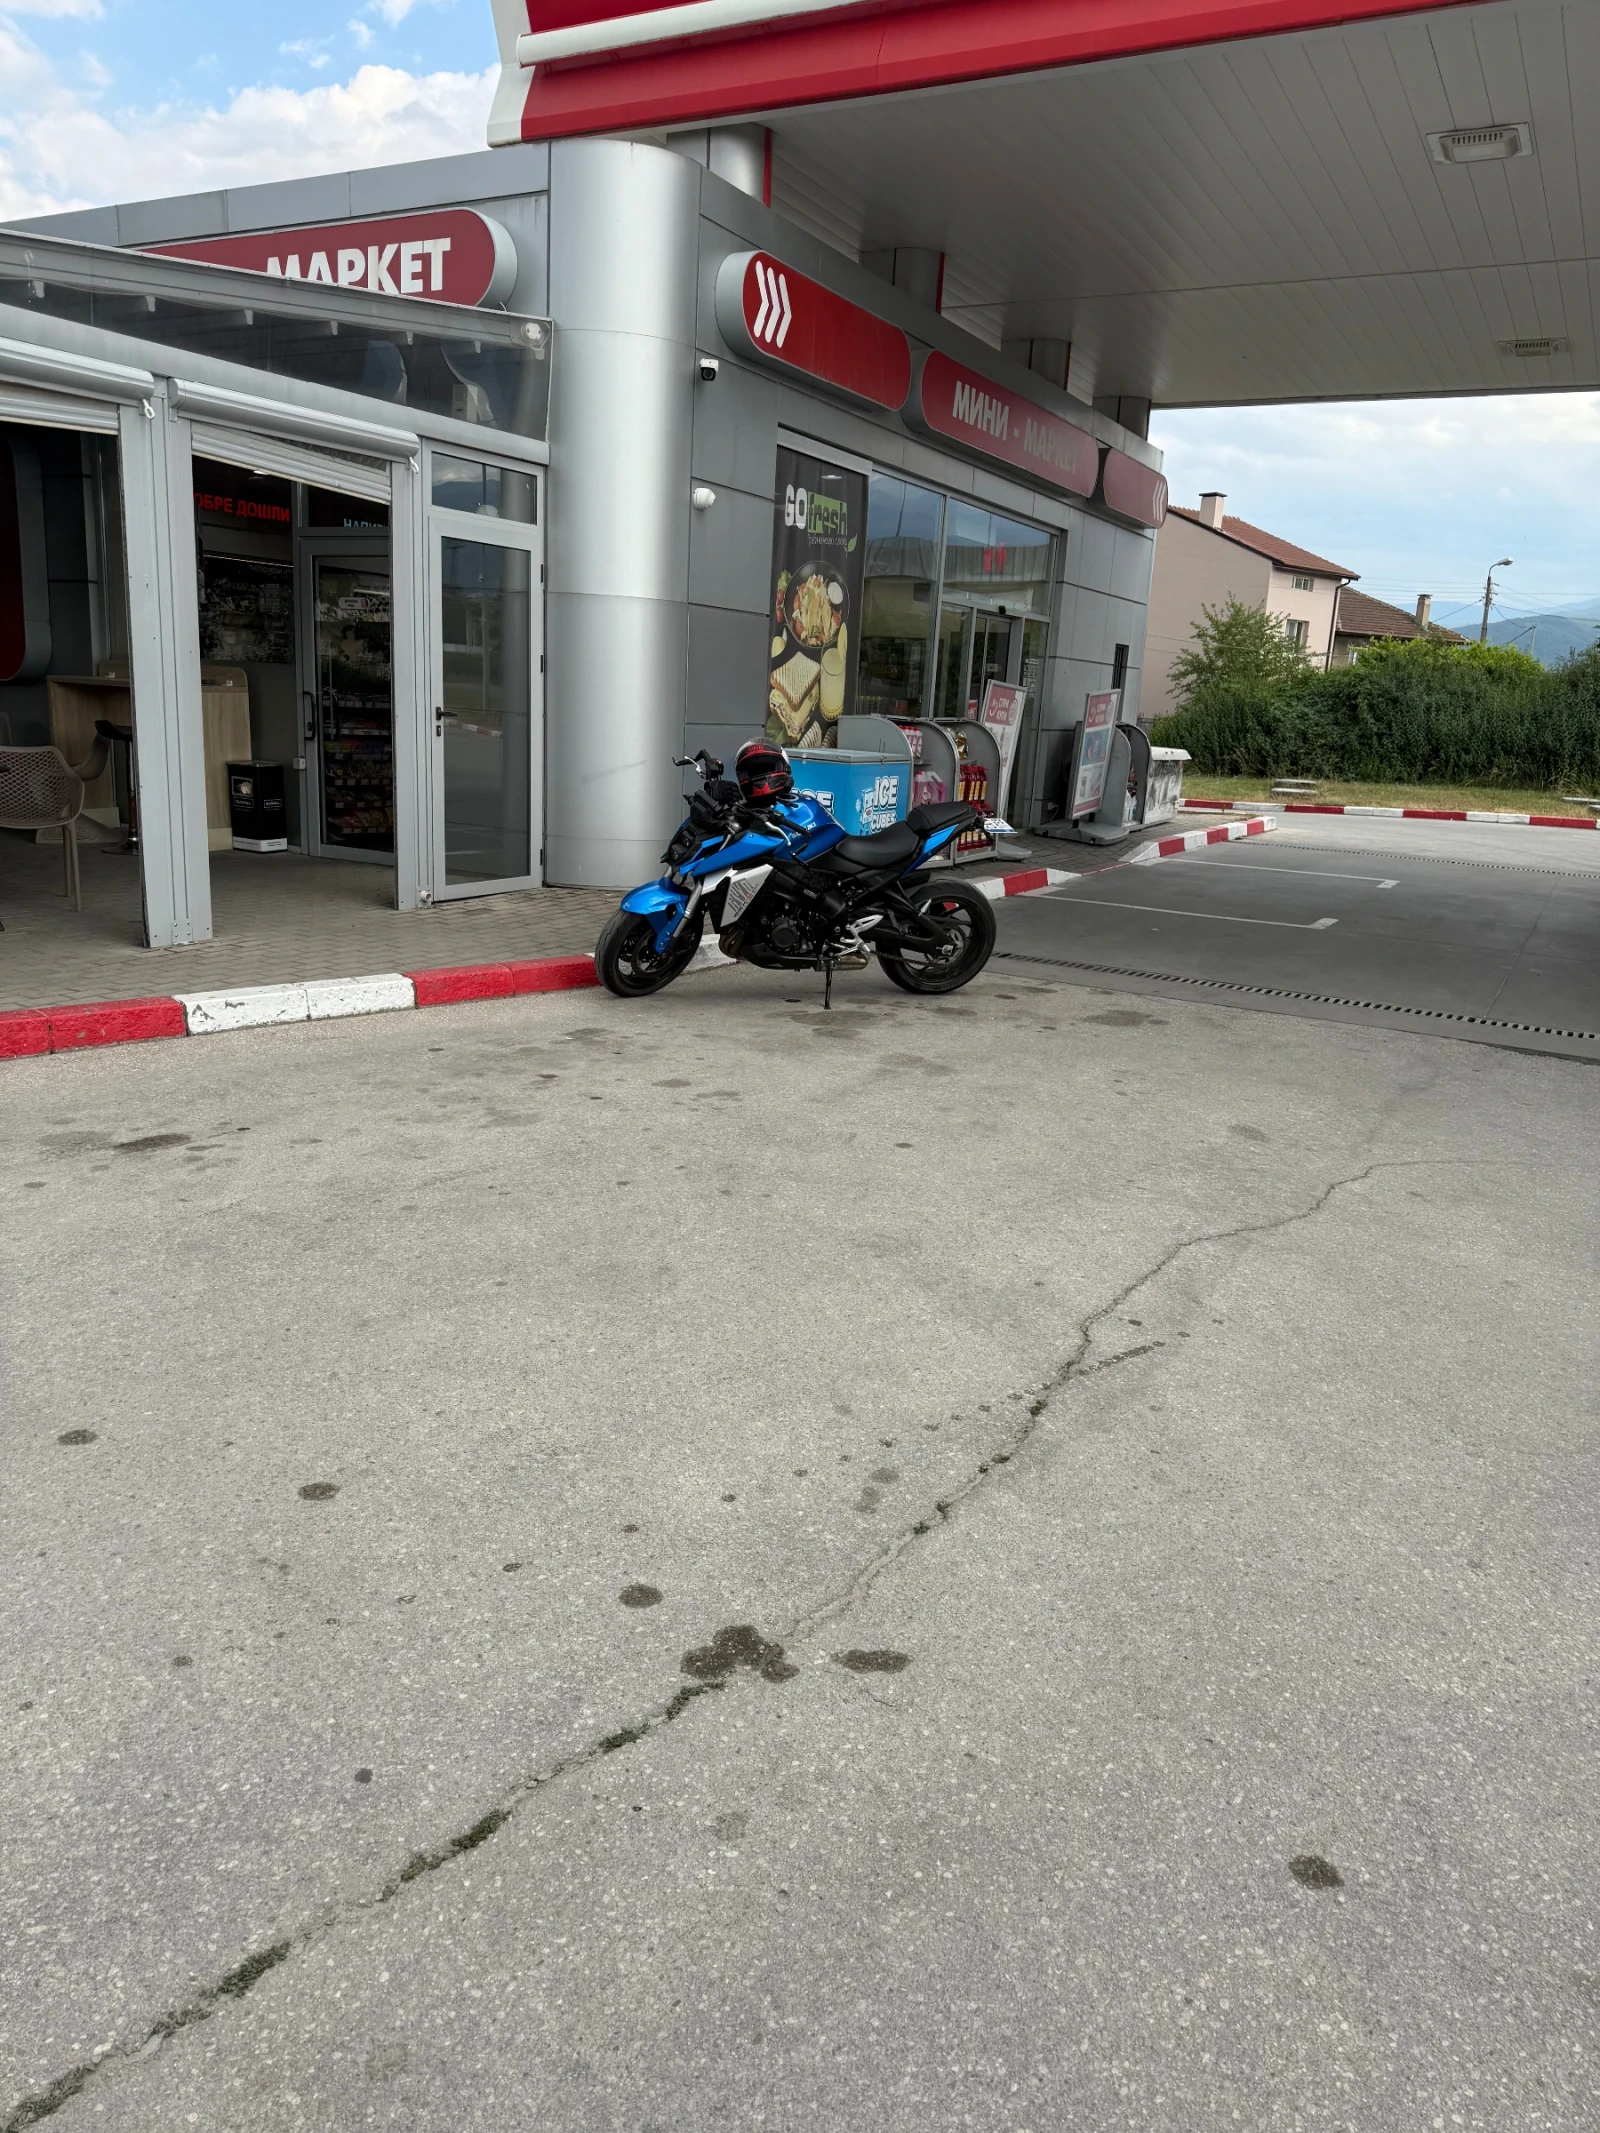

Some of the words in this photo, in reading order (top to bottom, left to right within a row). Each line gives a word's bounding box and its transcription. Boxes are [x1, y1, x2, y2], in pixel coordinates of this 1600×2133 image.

[952, 380, 1010, 442] МИНИ
[1023, 417, 1077, 474] МАРКЕТ
[194, 492, 233, 513] ОБРЕ
[236, 500, 290, 522] ДОШЛИ
[785, 484, 808, 530] GO
[808, 493, 848, 535] fresh
[872, 776, 899, 811] ICE
[871, 811, 897, 833] CUBES
